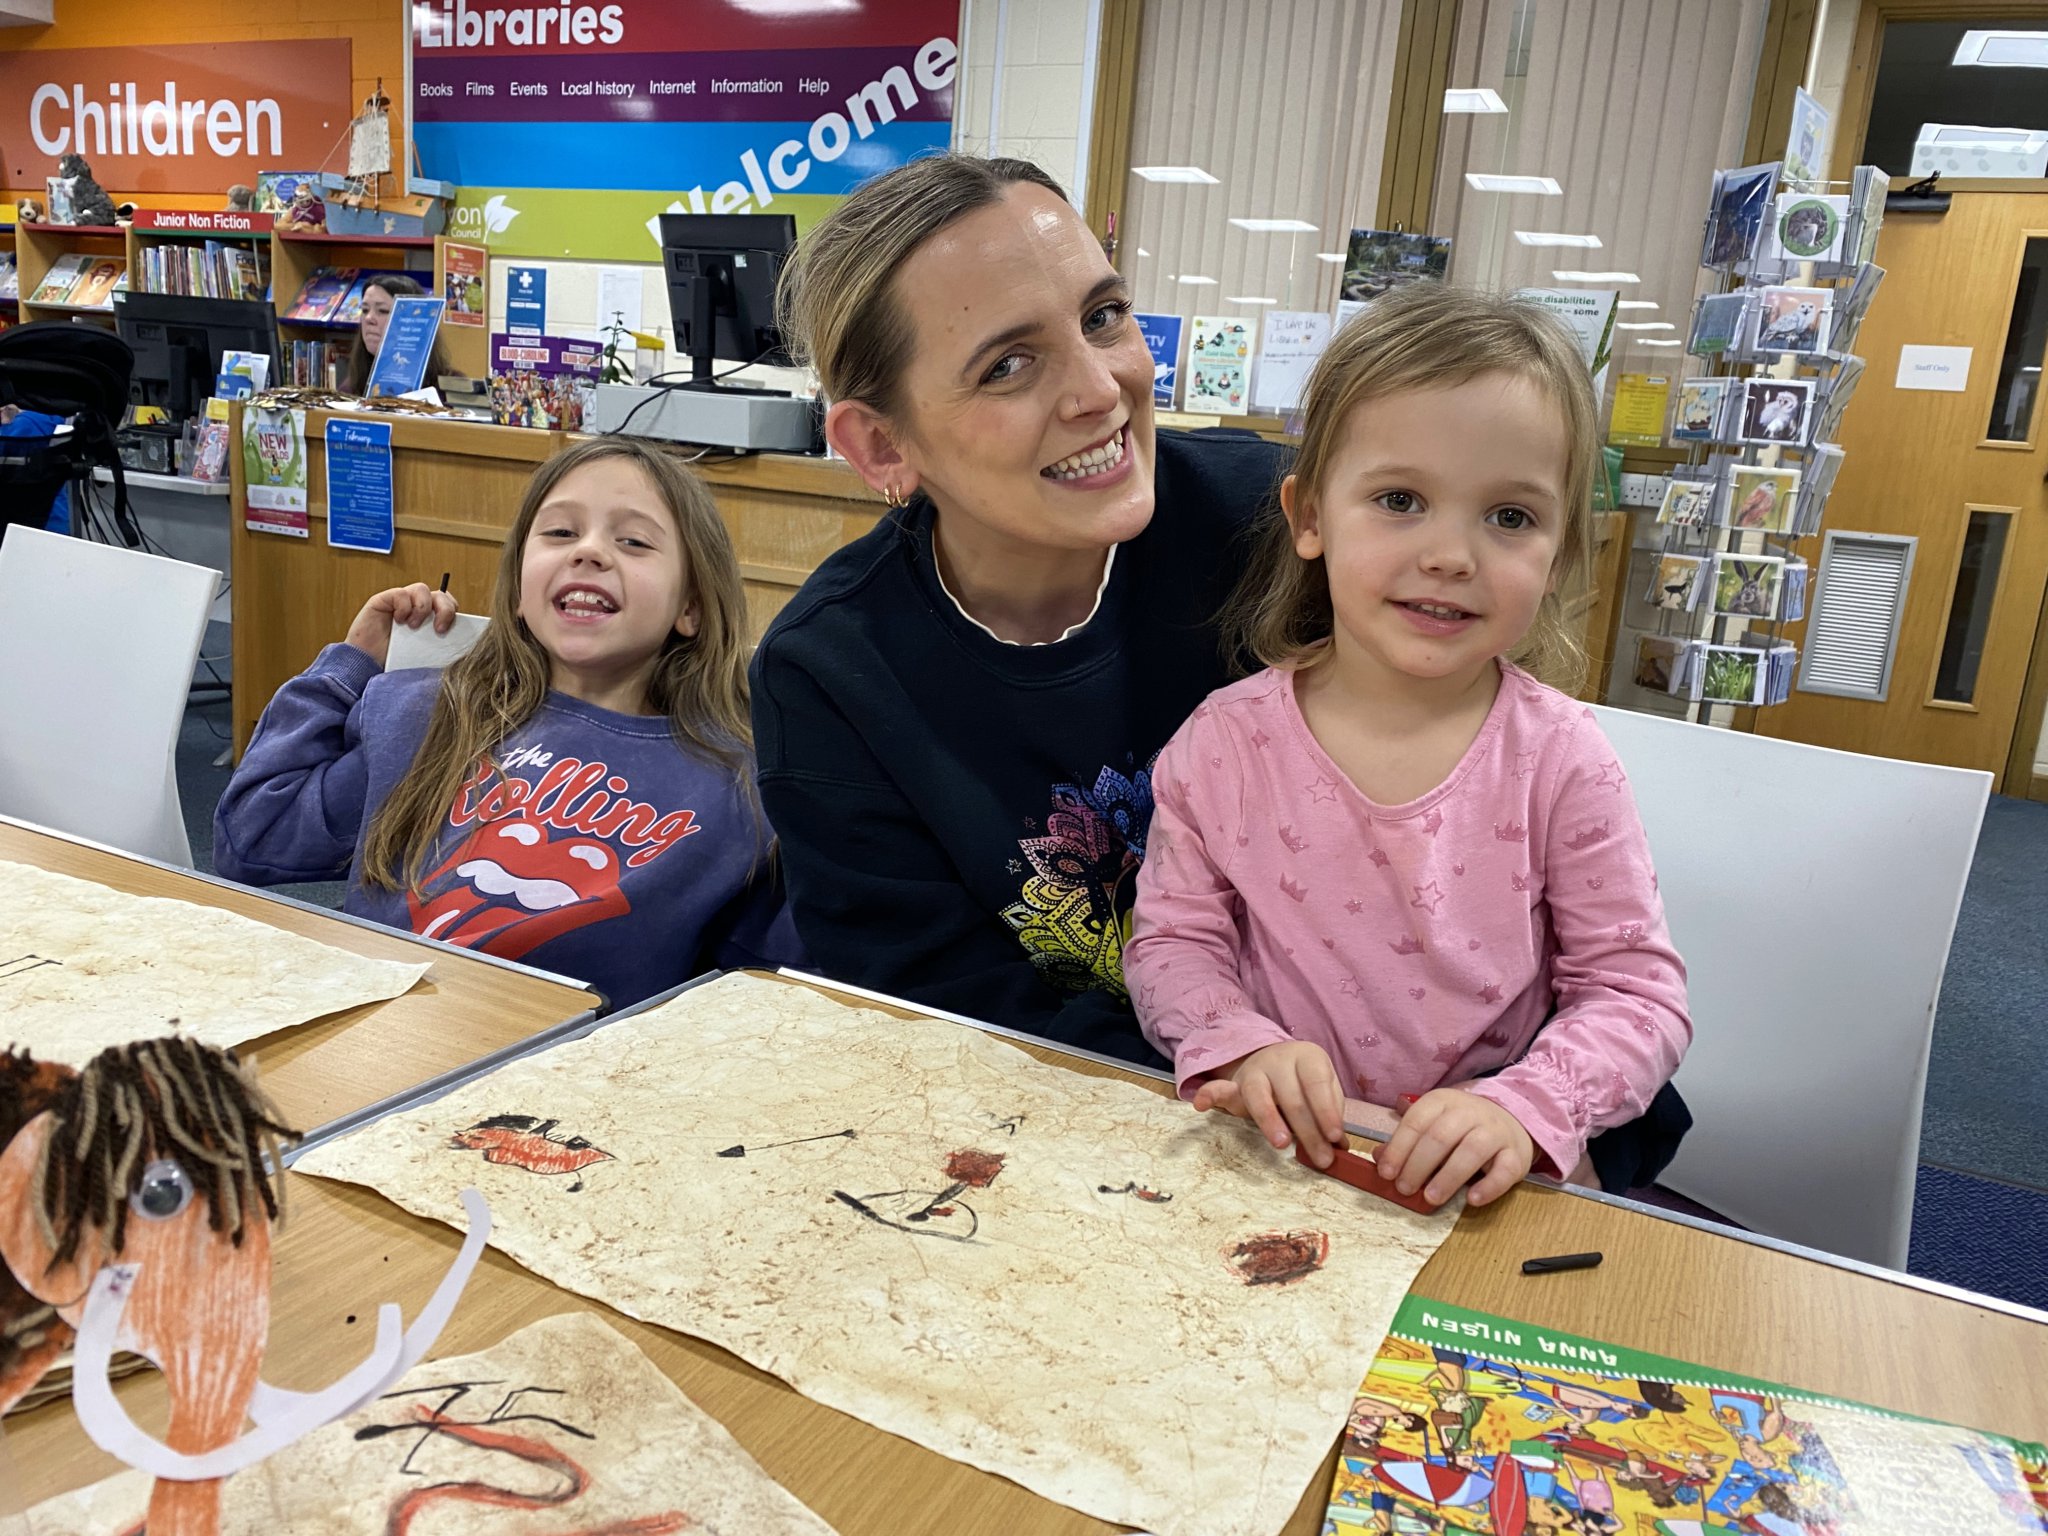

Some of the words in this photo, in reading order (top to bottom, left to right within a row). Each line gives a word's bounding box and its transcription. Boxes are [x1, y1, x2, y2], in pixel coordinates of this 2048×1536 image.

[421, 0, 624, 47] Libraries
[420, 83, 453, 97] Books
[466, 82, 495, 96] Films
[510, 82, 548, 96] Events
[561, 81, 592, 96] Local
[595, 81, 636, 98] history
[650, 80, 696, 94] Internet
[711, 79, 783, 93] Information
[799, 78, 830, 96] Help
[30, 81, 283, 157] Children
[153, 212, 186, 227] Junior
[188, 213, 211, 228] Non
[213, 214, 251, 230] Fiction
[448, 207, 481, 225] von
[451, 227, 482, 238] Council
[1544, 294, 1596, 305] disabilities
[1574, 308, 1599, 316] some
[1145, 335, 1166, 347] CTV
[1933, 364, 1950, 373] Only
[258, 433, 287, 450] NEW
[261, 450, 289, 460] WORLDS
[501, 743, 553, 771] the
[1422, 1312, 1521, 1346] NILSEN
[1538, 1336, 1617, 1366] ANNA
